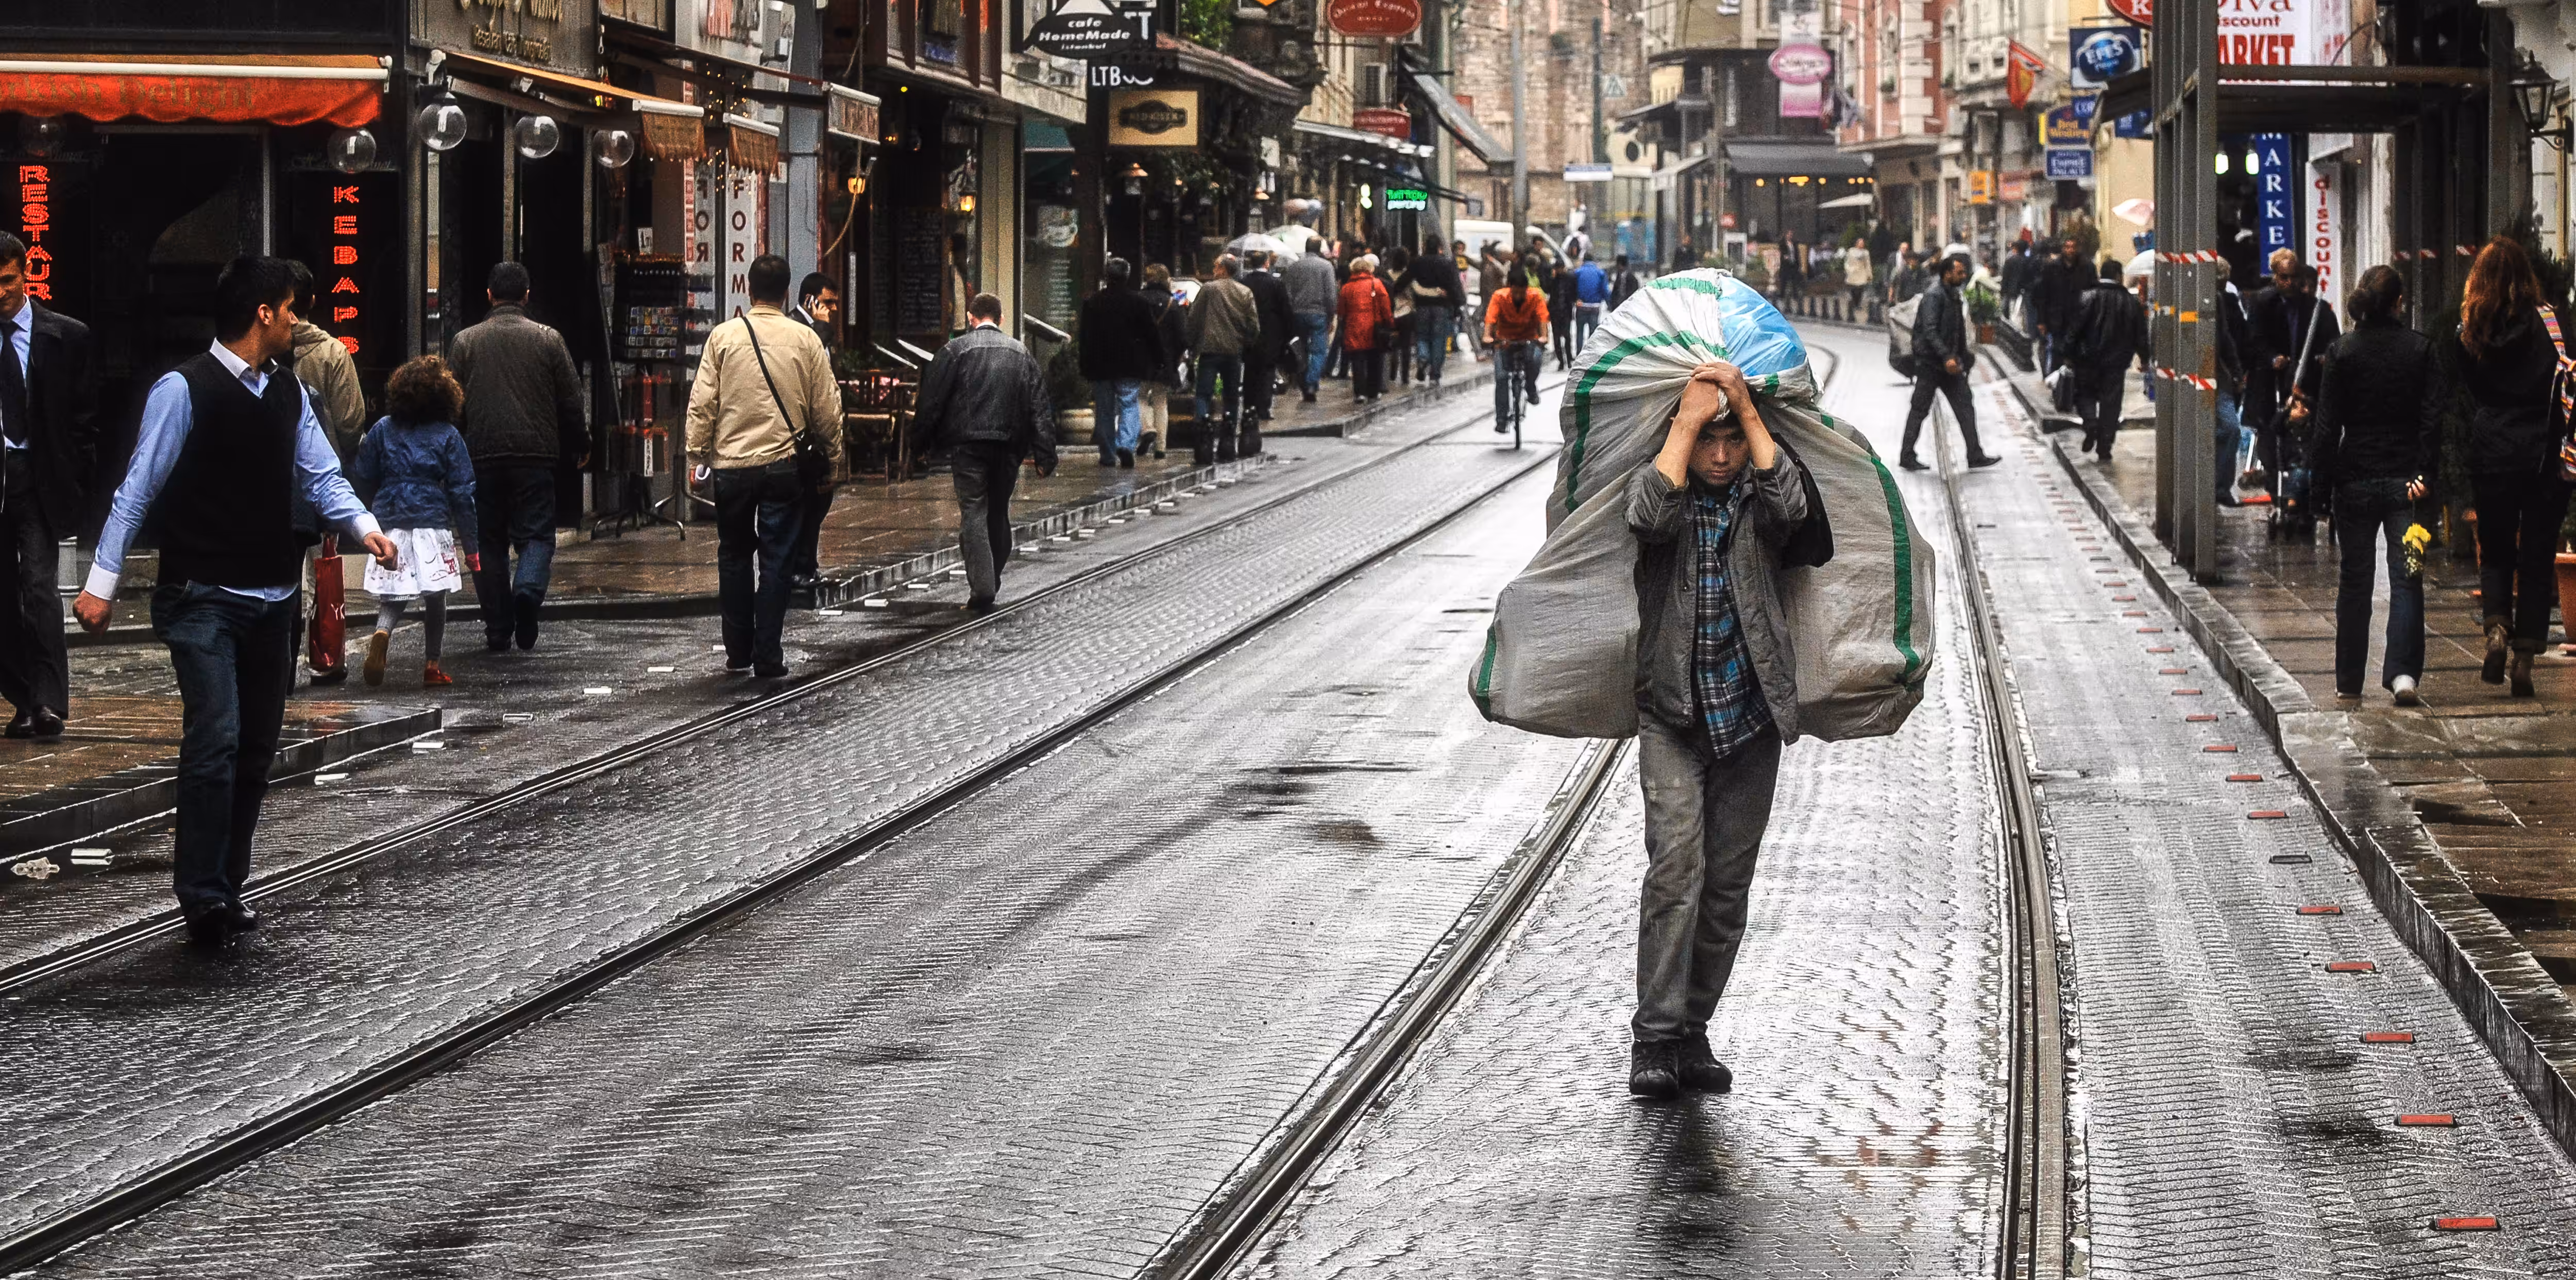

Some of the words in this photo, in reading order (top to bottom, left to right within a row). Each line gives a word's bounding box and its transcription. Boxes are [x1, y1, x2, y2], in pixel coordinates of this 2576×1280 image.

[1039, 29, 1131, 41] HomeMade
[1068, 17, 1102, 28] cafe
[1092, 66, 1121, 86] LTB
[0, 74, 102, 102] rkish
[118, 77, 255, 115] Delight
[20, 165, 52, 300] RESTAUR
[2315, 174, 2331, 293] discount
